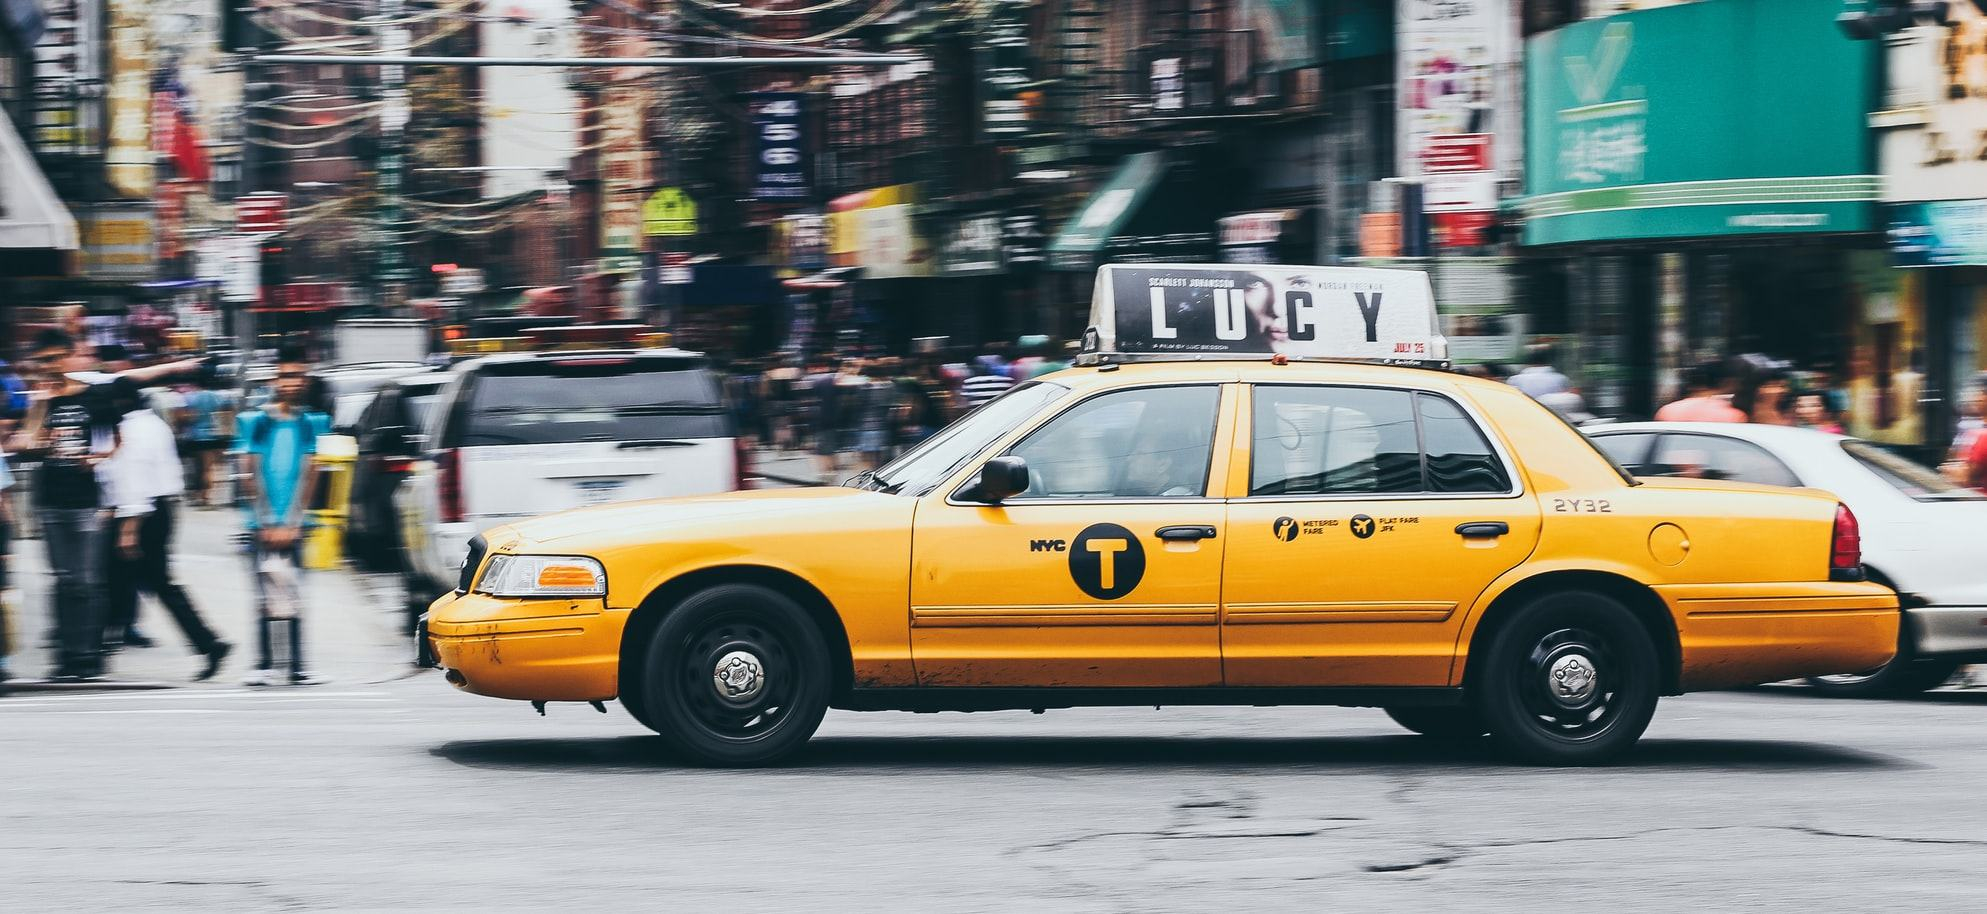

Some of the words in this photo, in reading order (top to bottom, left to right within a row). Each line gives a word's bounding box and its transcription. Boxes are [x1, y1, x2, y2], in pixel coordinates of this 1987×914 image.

[1150, 286, 1382, 343] LUCY
[1393, 343, 1412, 353] JULY
[1553, 498, 1612, 513] 2Y32
[1303, 519, 1339, 527] METERED
[1379, 517, 1398, 525] FLAT
[1399, 517, 1420, 525] FARE
[1303, 527, 1324, 535] FARE
[1029, 539, 1067, 552] NYC
[1085, 537, 1128, 590] T
